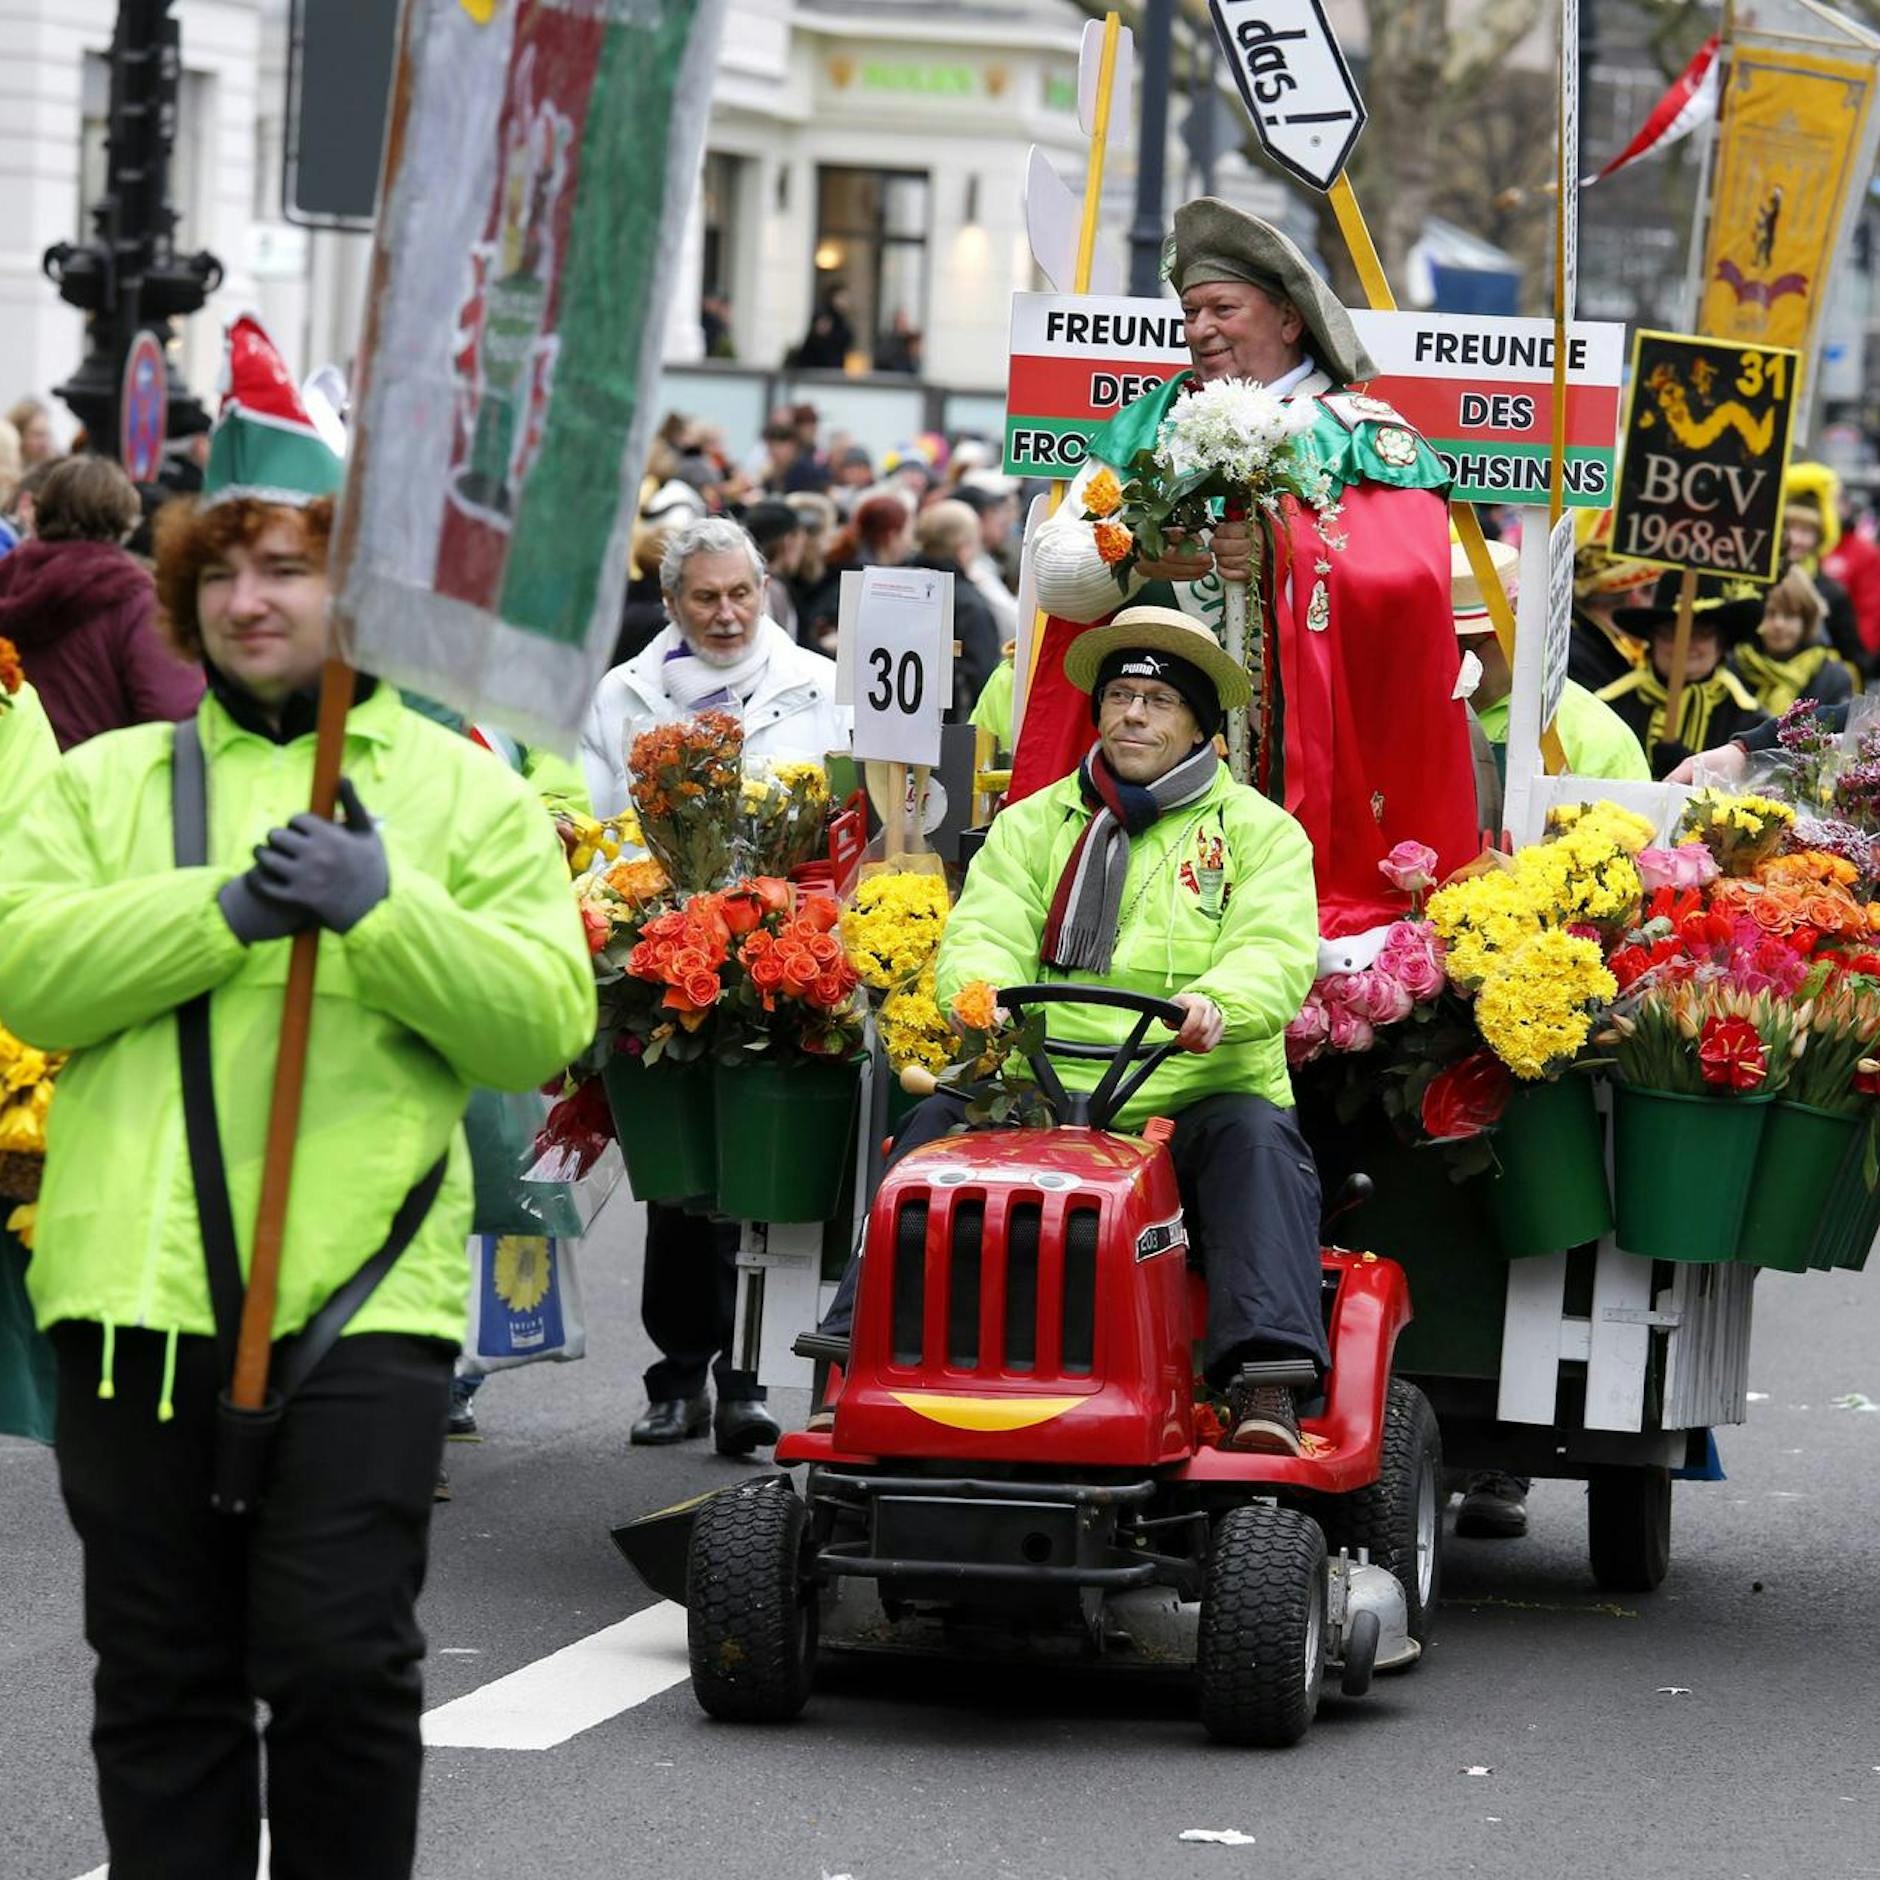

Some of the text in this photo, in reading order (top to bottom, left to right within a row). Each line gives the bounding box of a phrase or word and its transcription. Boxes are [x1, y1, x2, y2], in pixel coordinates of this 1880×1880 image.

[1236, 20, 1353, 126] das!
[1046, 312, 1189, 349] FREUND
[1415, 331, 1587, 370] FREUNDE
[1736, 351, 1786, 400] 31
[1460, 393, 1534, 431] DES
[1012, 430, 1090, 464] FRO
[1638, 454, 1768, 517] BCV
[867, 647, 924, 715] 30
[1121, 664, 1153, 675] PUMA
